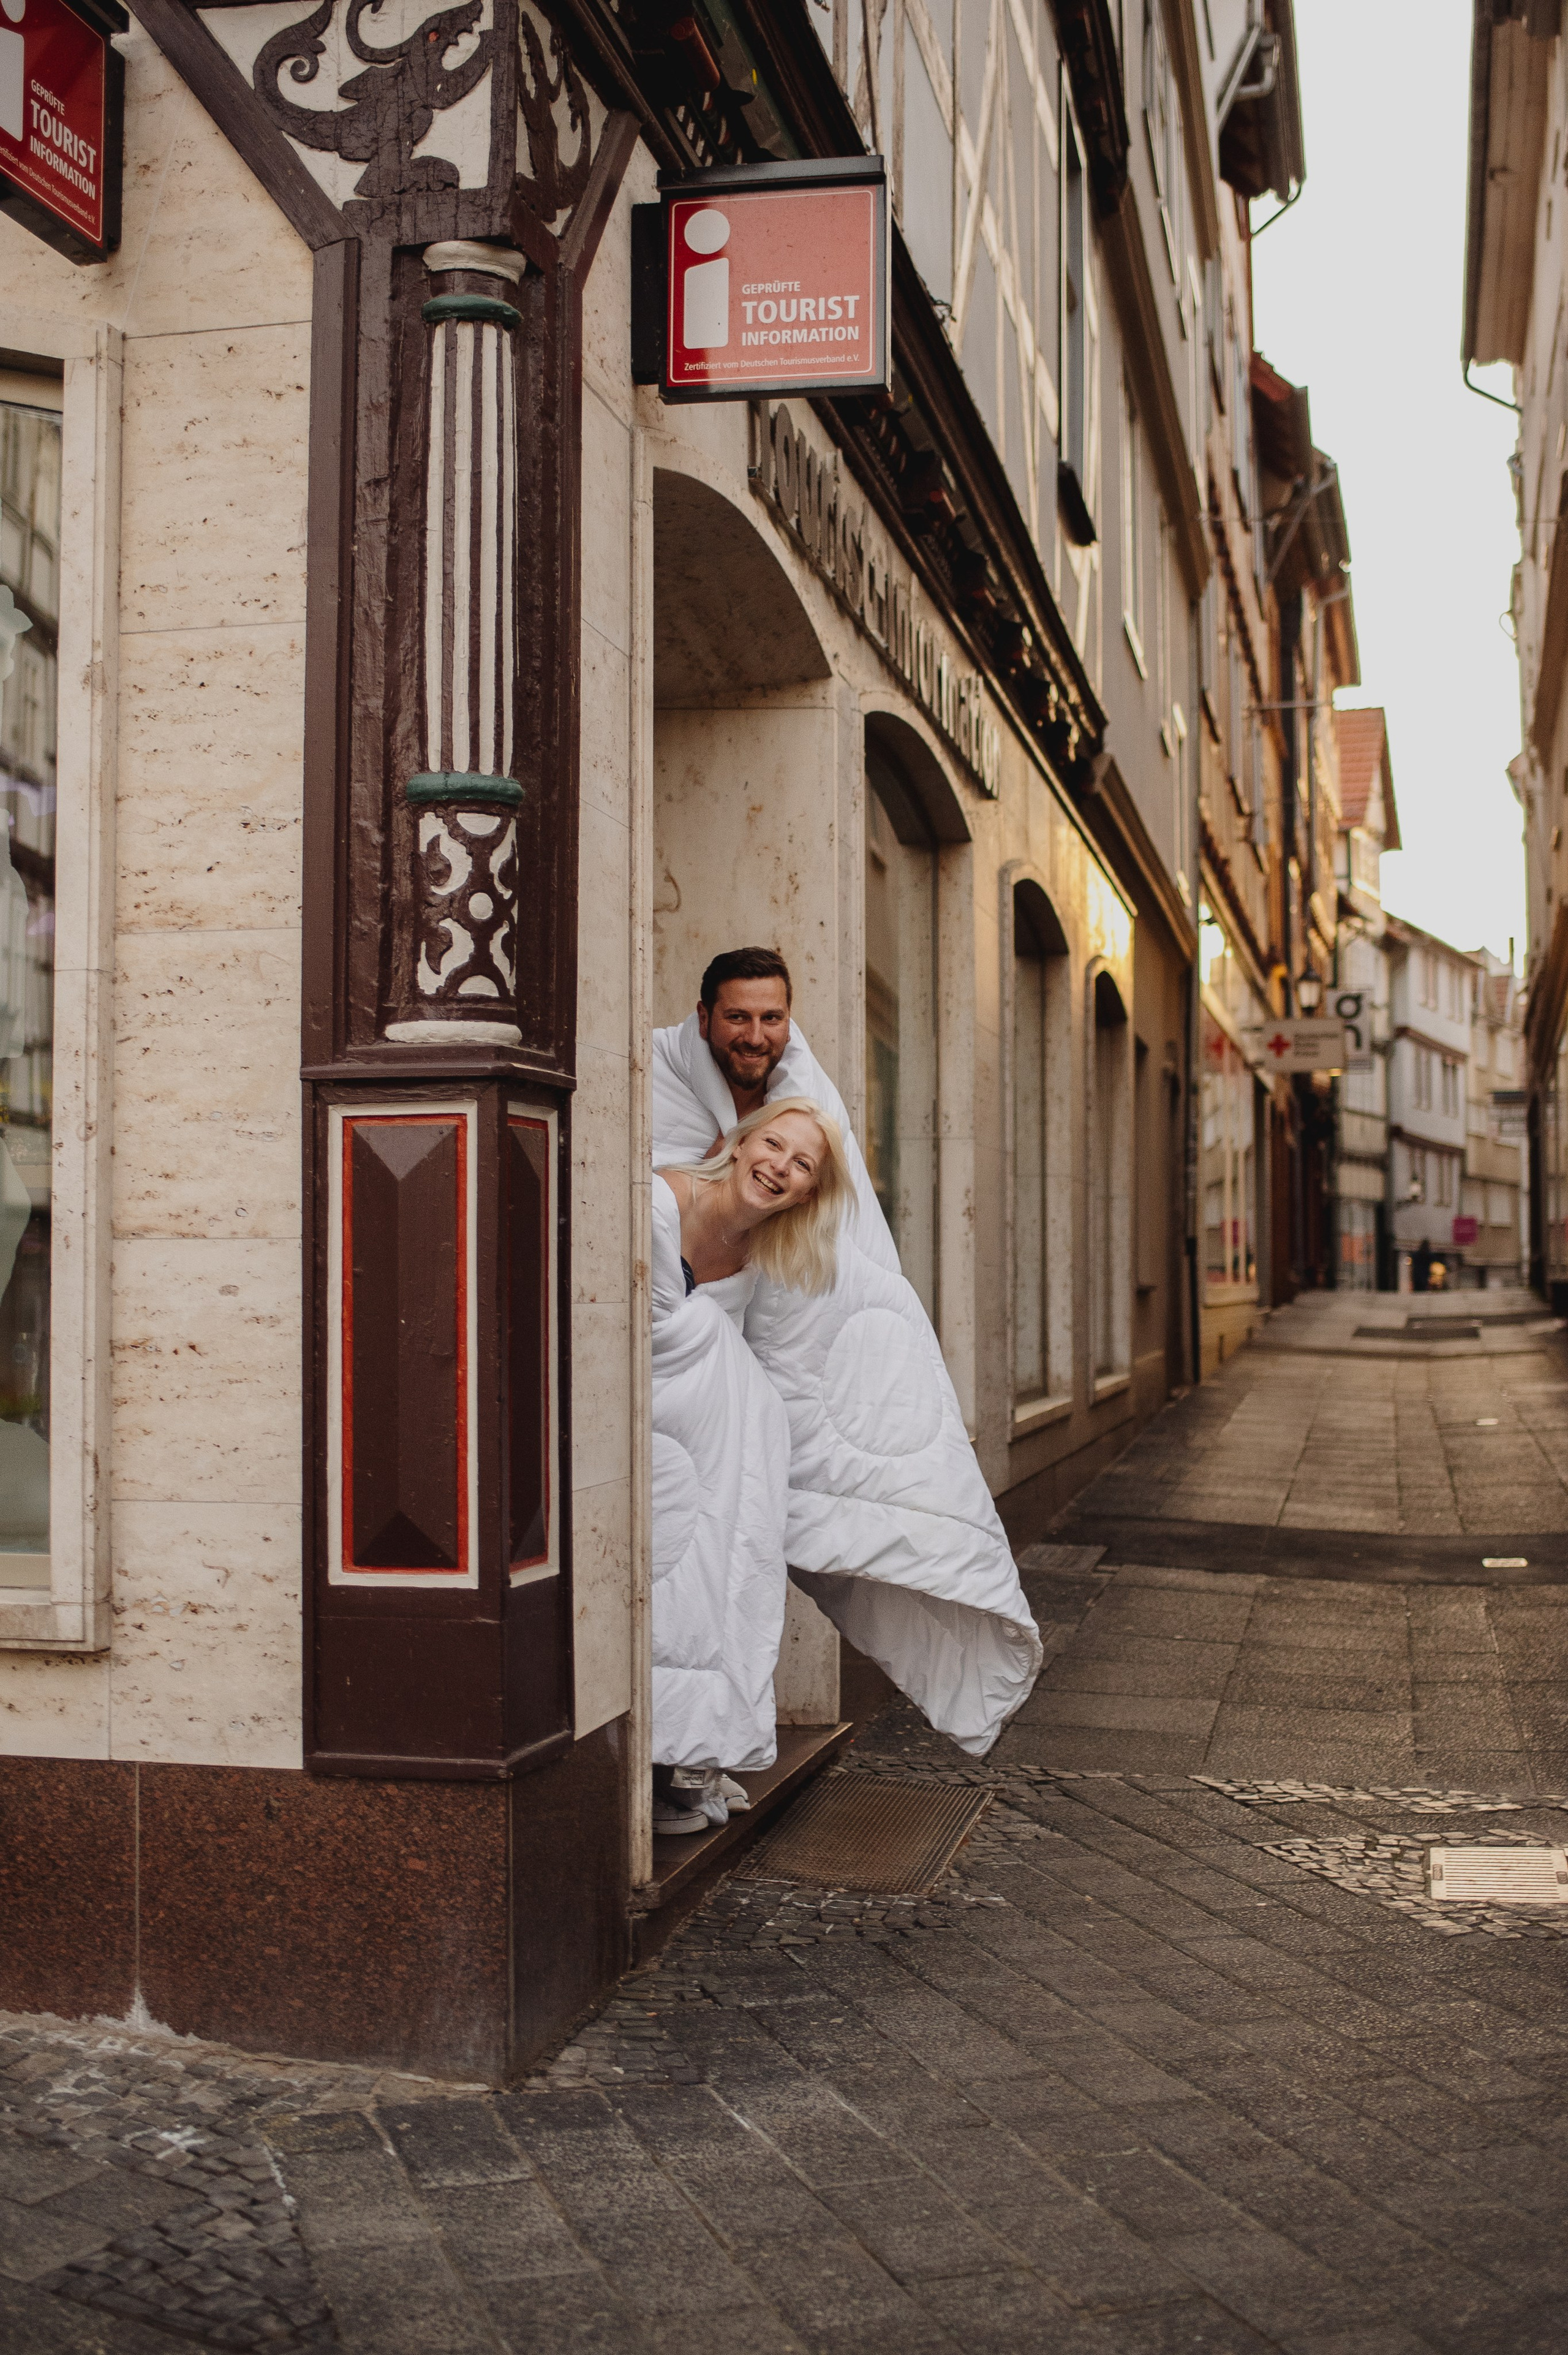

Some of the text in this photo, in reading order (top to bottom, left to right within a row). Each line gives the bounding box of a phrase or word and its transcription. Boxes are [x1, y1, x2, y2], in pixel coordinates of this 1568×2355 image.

[31, 79, 65, 116] GEPRÜFTE
[31, 99, 97, 174] TOURIST
[0, 146, 18, 166] ertifiziert
[29, 167, 51, 191] Deutschen
[51, 184, 88, 219] Tourismusverband
[31, 135, 96, 200] INFORMATION
[742, 280, 801, 295] GEPRÜFTE
[741, 295, 860, 325] TOURIST
[741, 326, 859, 346] INFORMATION
[684, 353, 860, 372] Zertifiziert vom Deutschen Tourismusverband e.V.
